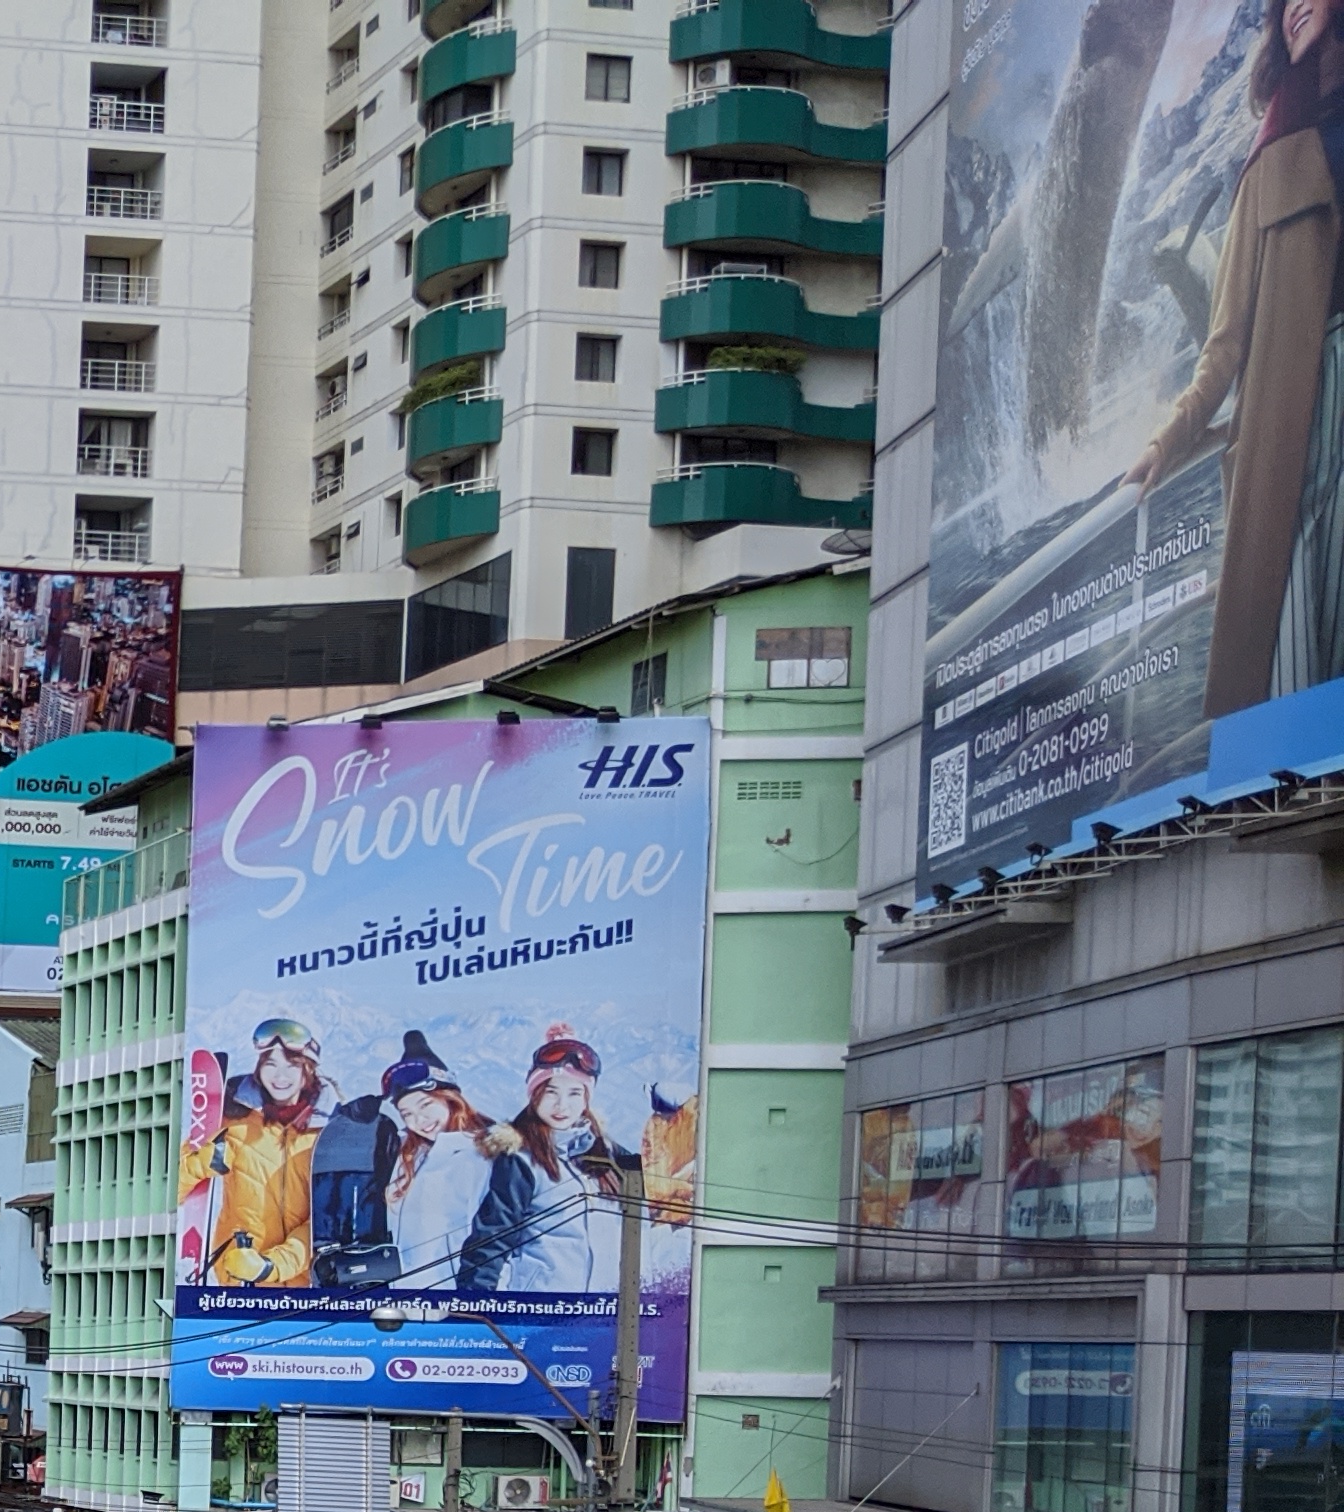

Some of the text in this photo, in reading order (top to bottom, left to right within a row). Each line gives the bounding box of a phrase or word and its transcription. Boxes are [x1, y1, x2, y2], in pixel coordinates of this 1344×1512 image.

[975, 719, 1018, 758] Citigold
[1018, 712, 1110, 777] 0-2081-0999
[16, 774, 82, 795] แอชตัน
[328, 748, 391, 805] It's
[638, 790, 677, 798] TRAVEL
[971, 740, 1135, 832] www.citibank.co.th/citigold
[13, 859, 54, 869] STARTS
[222, 755, 494, 919] Snow
[467, 813, 683, 933] Time
[277, 907, 486, 978] หนาวนี้ที่ญี่ปุ่น
[416, 918, 635, 986] ไปเล่นหิมะกัน!!
[215, 1361, 362, 1376] www ski.histours.co.th
[422, 1365, 520, 1378] 02-022-0933
